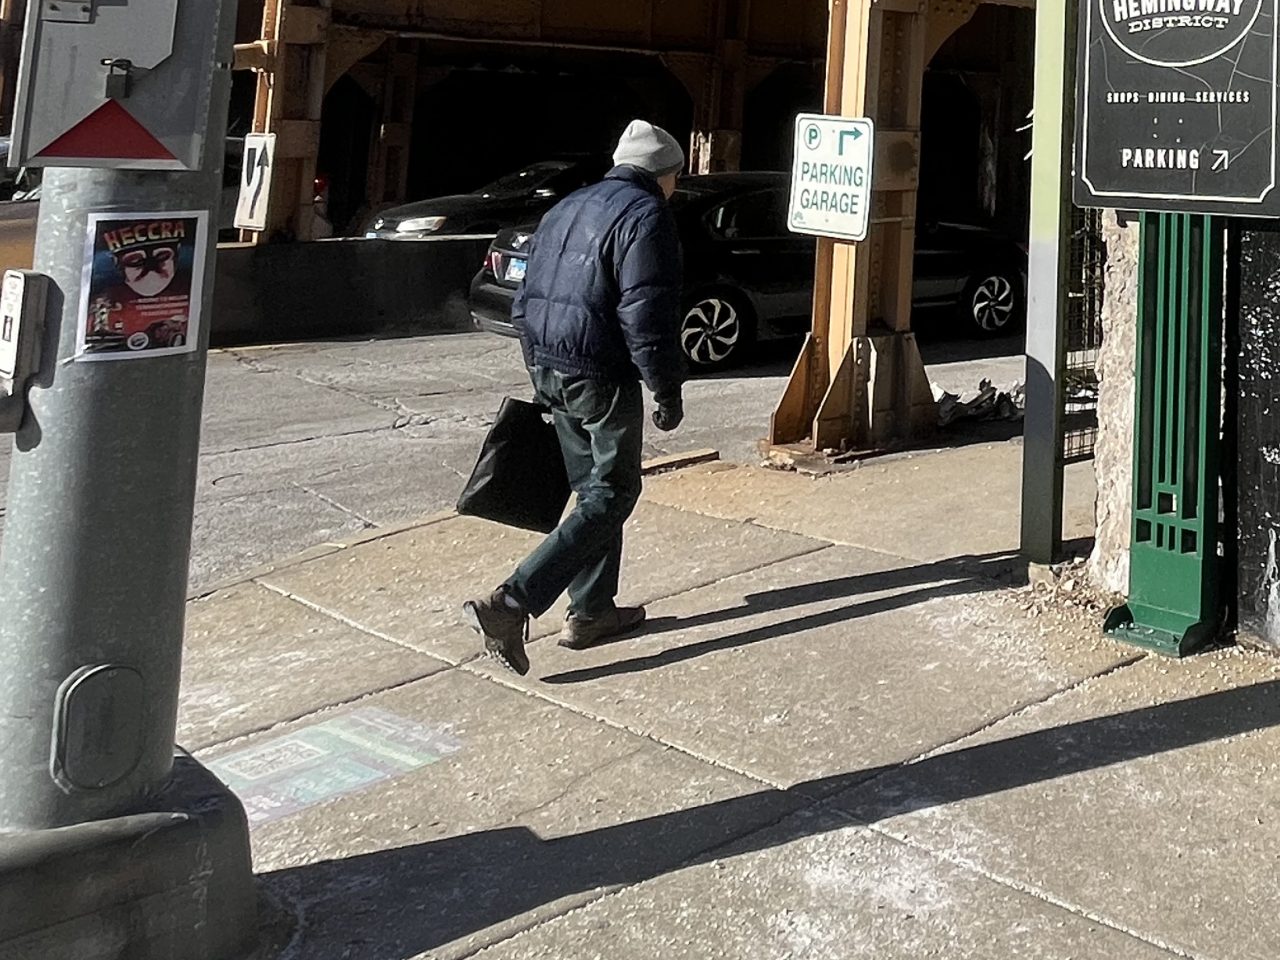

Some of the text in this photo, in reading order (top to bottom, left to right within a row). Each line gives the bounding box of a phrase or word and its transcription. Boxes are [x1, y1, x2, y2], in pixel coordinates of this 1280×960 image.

[1127, 15, 1228, 33] DISTRICT
[1106, 91, 1139, 102] SHOPS
[1195, 90, 1249, 102] SERVICES
[808, 128, 818, 144] P
[1121, 148, 1199, 169] PARKING
[801, 161, 862, 186] PARKING
[799, 188, 858, 213] GARAGE
